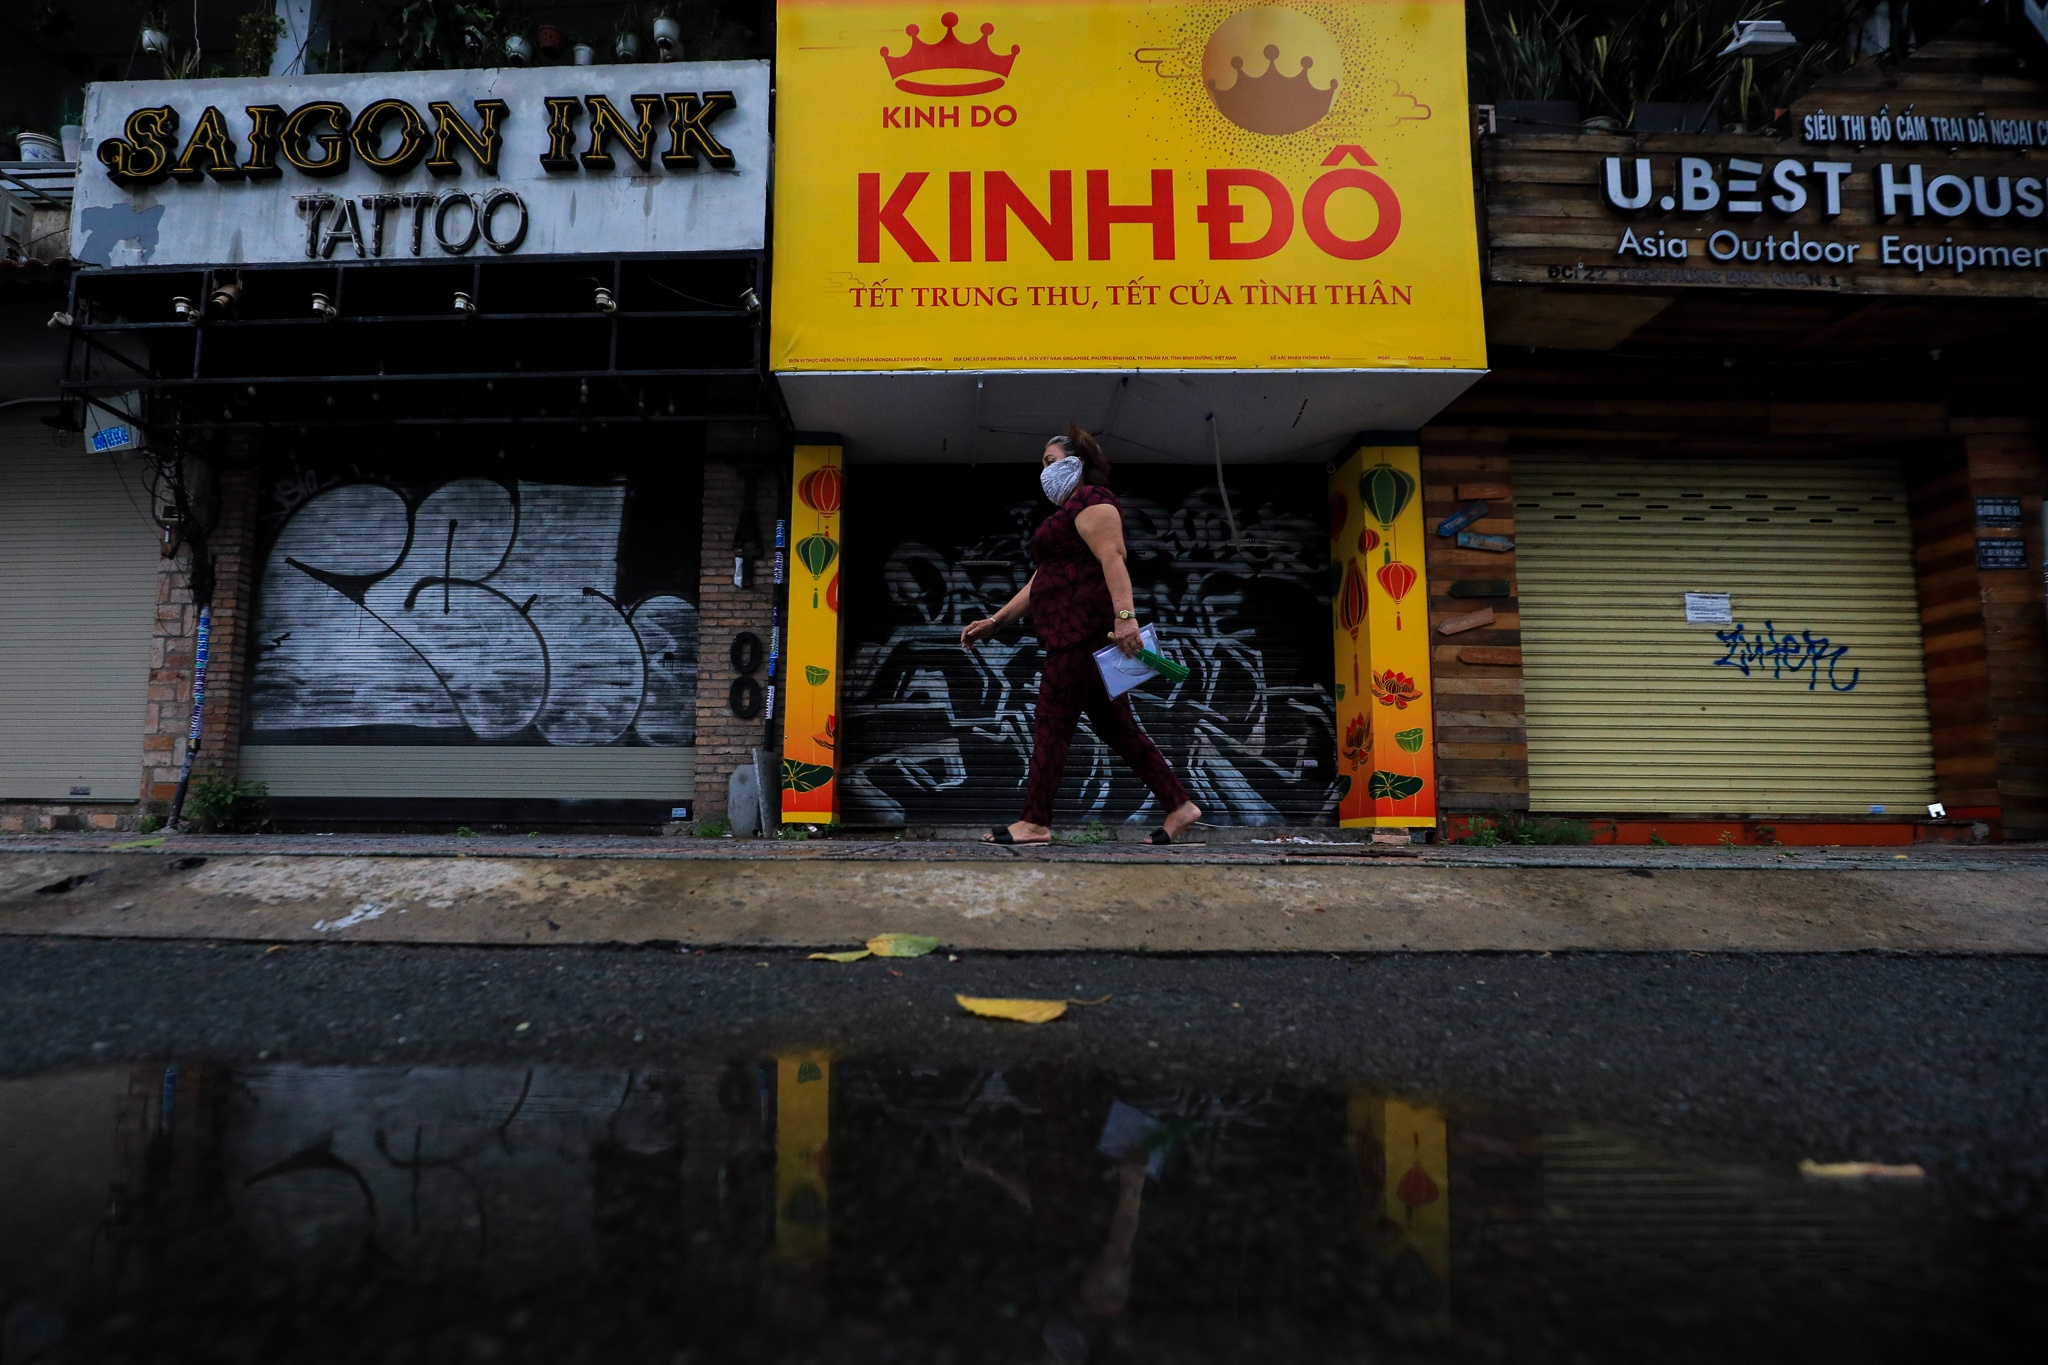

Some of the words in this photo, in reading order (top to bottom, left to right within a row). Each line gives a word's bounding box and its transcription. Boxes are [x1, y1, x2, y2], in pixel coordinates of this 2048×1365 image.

[97, 98, 510, 187] SAIGON
[540, 91, 736, 172] INK
[882, 105, 960, 129] KINH
[970, 104, 1018, 128] DO
[1804, 108, 1838, 141] SIÊU
[1841, 115, 1867, 149] THỊ
[1870, 103, 1892, 141] ĐỒ
[1896, 103, 1928, 142] CẮM
[1930, 116, 1964, 151] TRẠI
[1967, 111, 1988, 143] DÃ
[1990, 118, 2033, 152] NGOẠI
[857, 168, 1176, 264] KINH
[1196, 144, 1402, 261] ĐÔ
[1606, 156, 1853, 215] U.BEST
[1879, 162, 2048, 218] HOUS
[292, 188, 528, 258] TATTOO
[1618, 226, 1688, 258] Asia
[1708, 229, 1861, 264] Outdoor
[850, 278, 904, 308] TẾT
[911, 286, 1019, 307] TRUNG
[1026, 285, 1099, 310] THU,
[1105, 279, 1161, 305] TẾT
[1169, 279, 1234, 306] CỦA
[1240, 279, 1318, 305] TÌNH
[1324, 279, 1413, 305] THÂN
